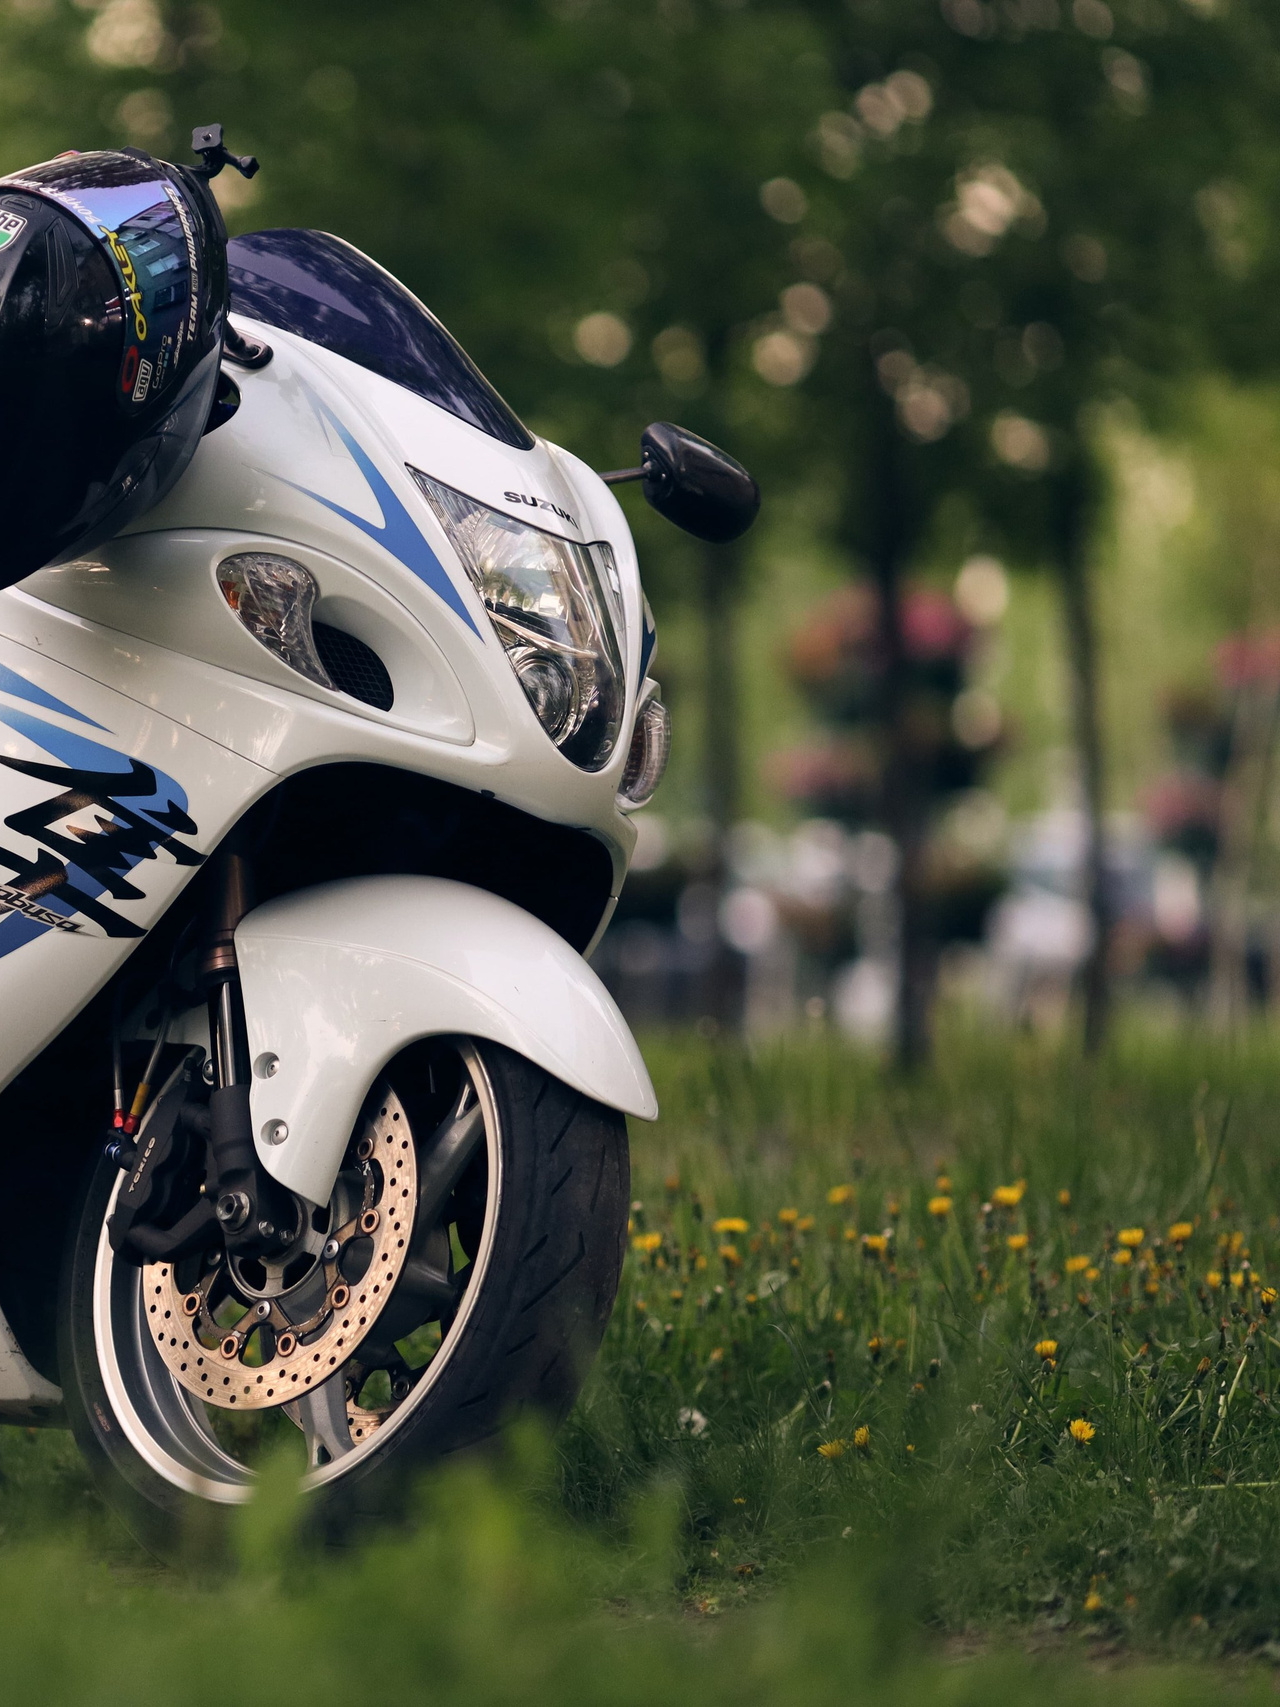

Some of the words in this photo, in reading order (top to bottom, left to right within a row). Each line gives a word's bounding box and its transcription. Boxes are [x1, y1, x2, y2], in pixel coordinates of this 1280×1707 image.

[164, 186, 198, 271] PHILIPPINES
[98, 225, 148, 341] OAKLEY
[187, 294, 198, 341] TEAM
[135, 364, 151, 397] agv
[152, 335, 167, 389] GoPro
[503, 491, 579, 530] SUZUKI
[128, 1137, 156, 1193] TOKICO
